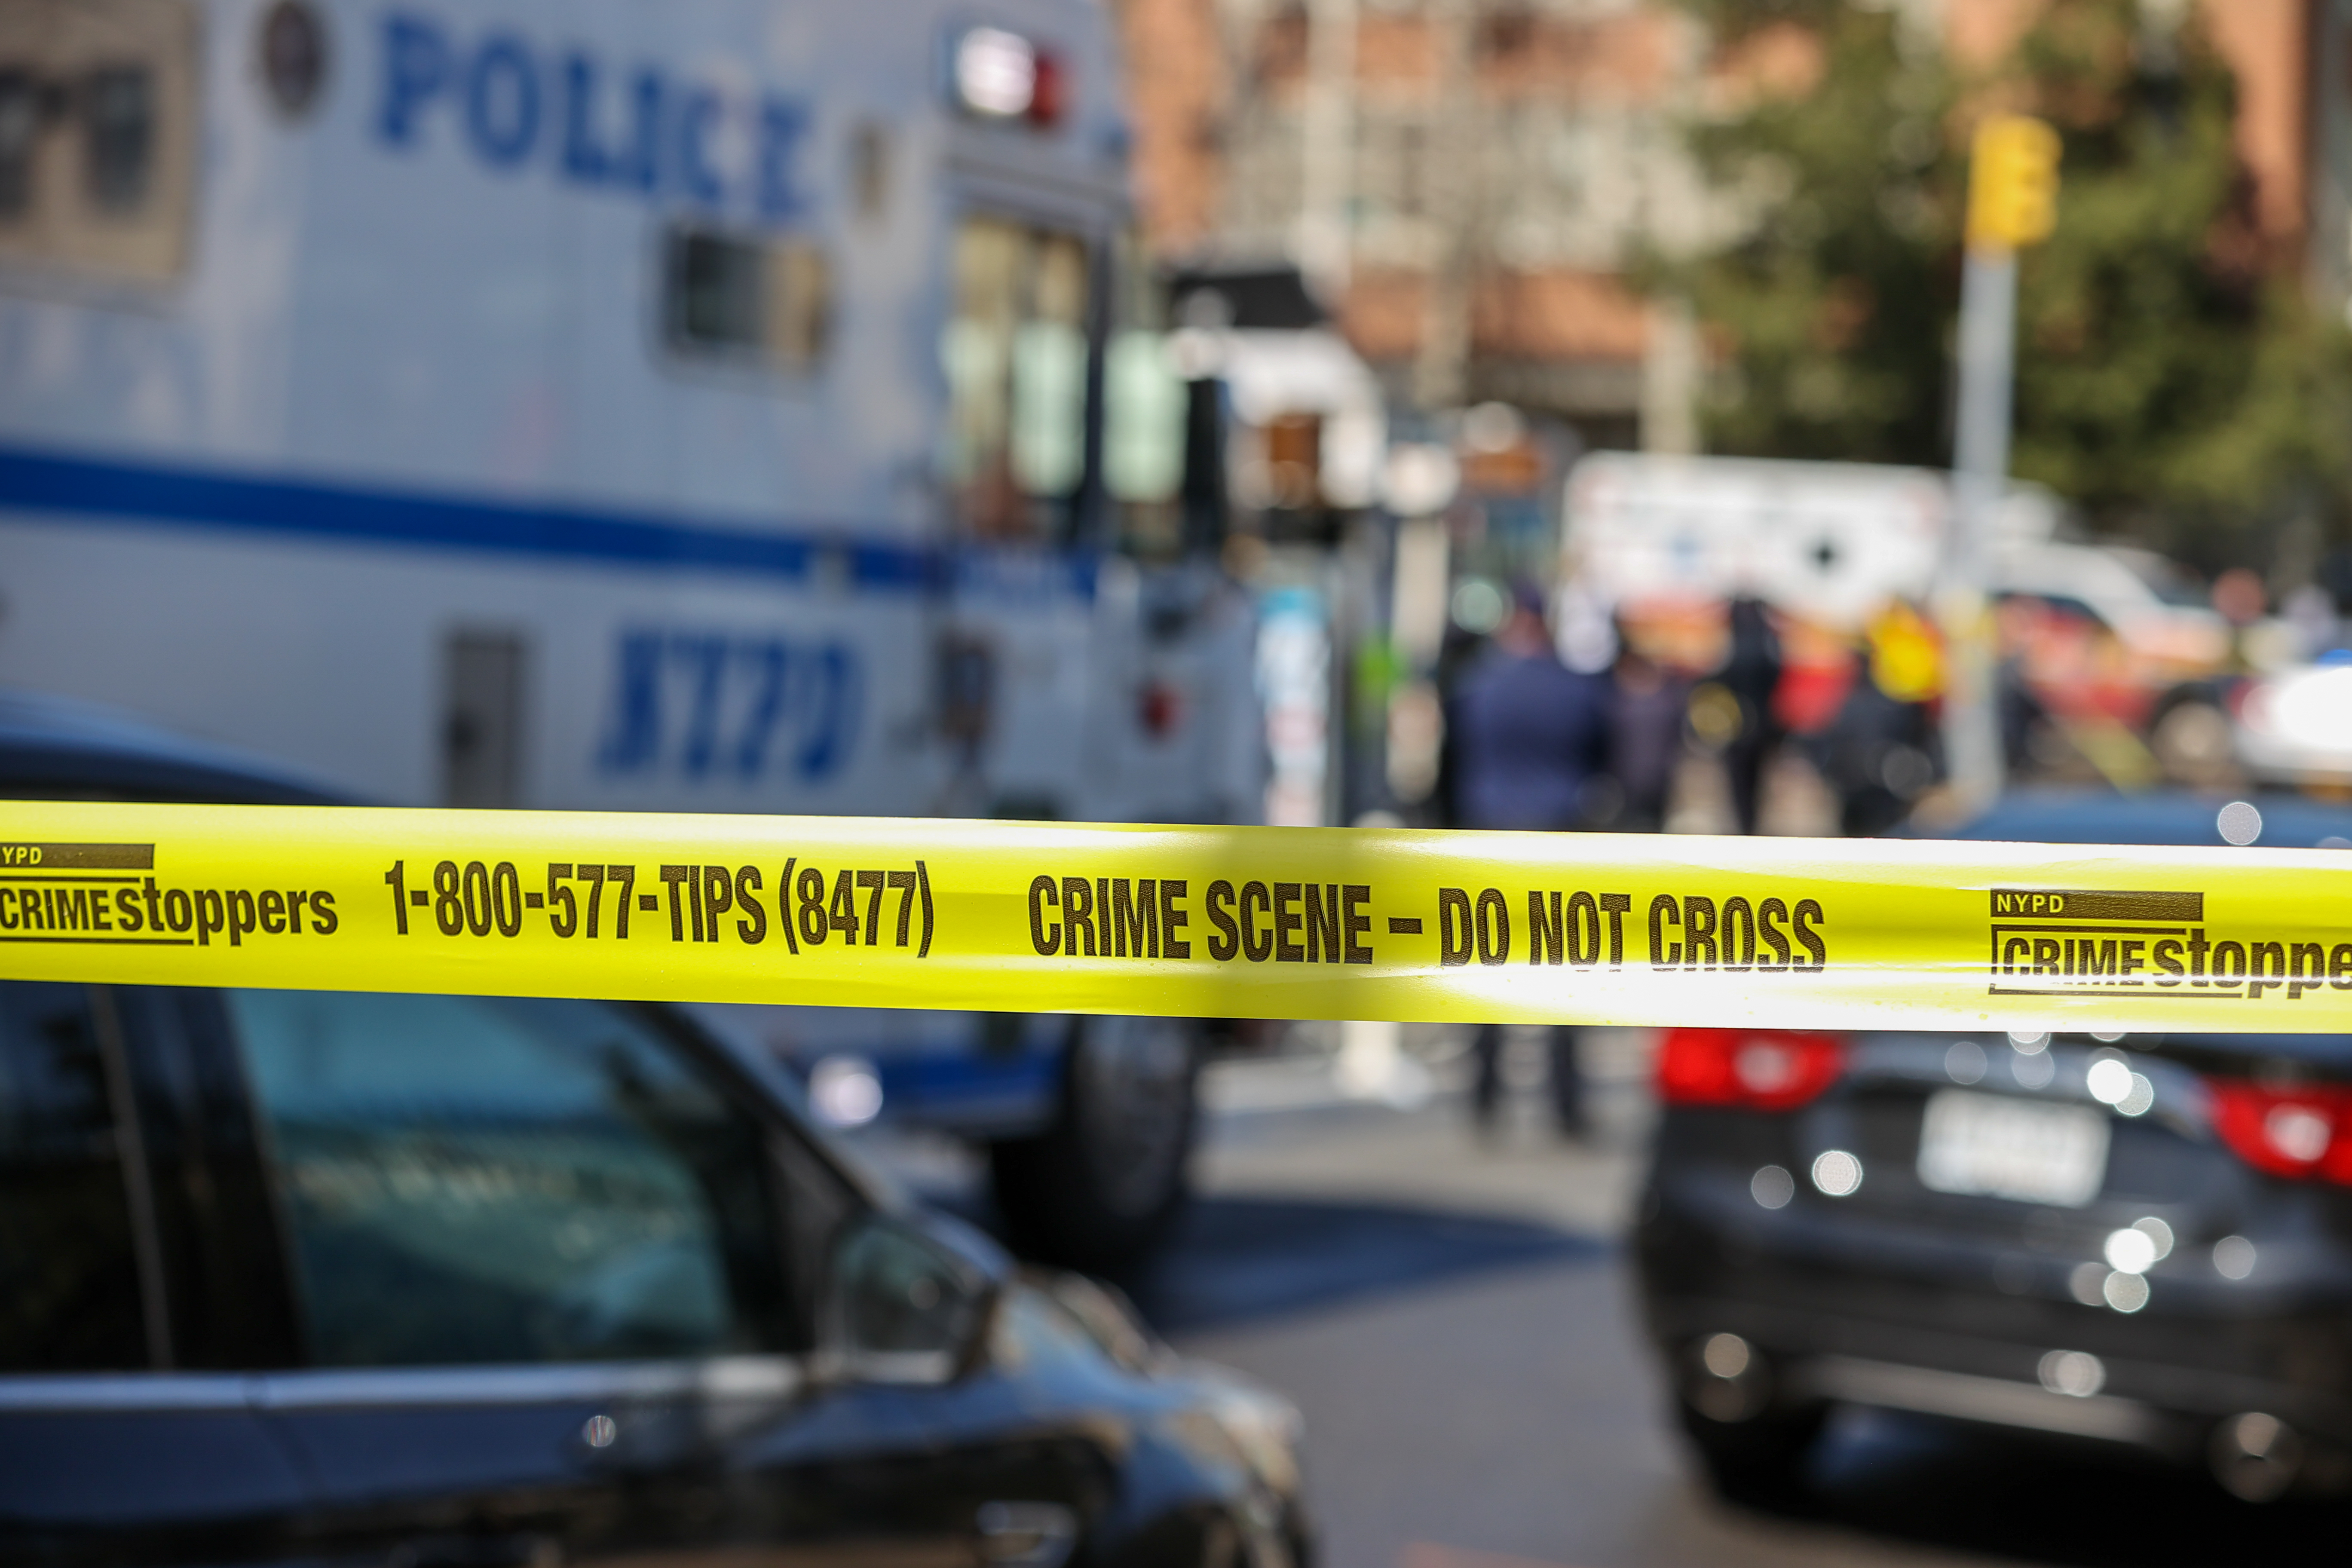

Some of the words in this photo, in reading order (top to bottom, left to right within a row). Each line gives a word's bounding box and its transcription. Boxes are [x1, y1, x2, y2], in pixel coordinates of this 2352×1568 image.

[375, 14, 812, 221] POLICE
[0, 888, 112, 930] CRIME
[385, 860, 767, 945] 1-800-577-TIPS
[779, 858, 934, 959] (8477)
[1028, 875, 1191, 959] CRIME
[1204, 879, 1374, 965] SCENE
[1438, 887, 1510, 967] DO
[1528, 890, 1632, 972] NOT
[1648, 894, 1826, 973] CROSS
[1997, 894, 2064, 913] NYPD
[2003, 937, 2146, 986] CRIME
